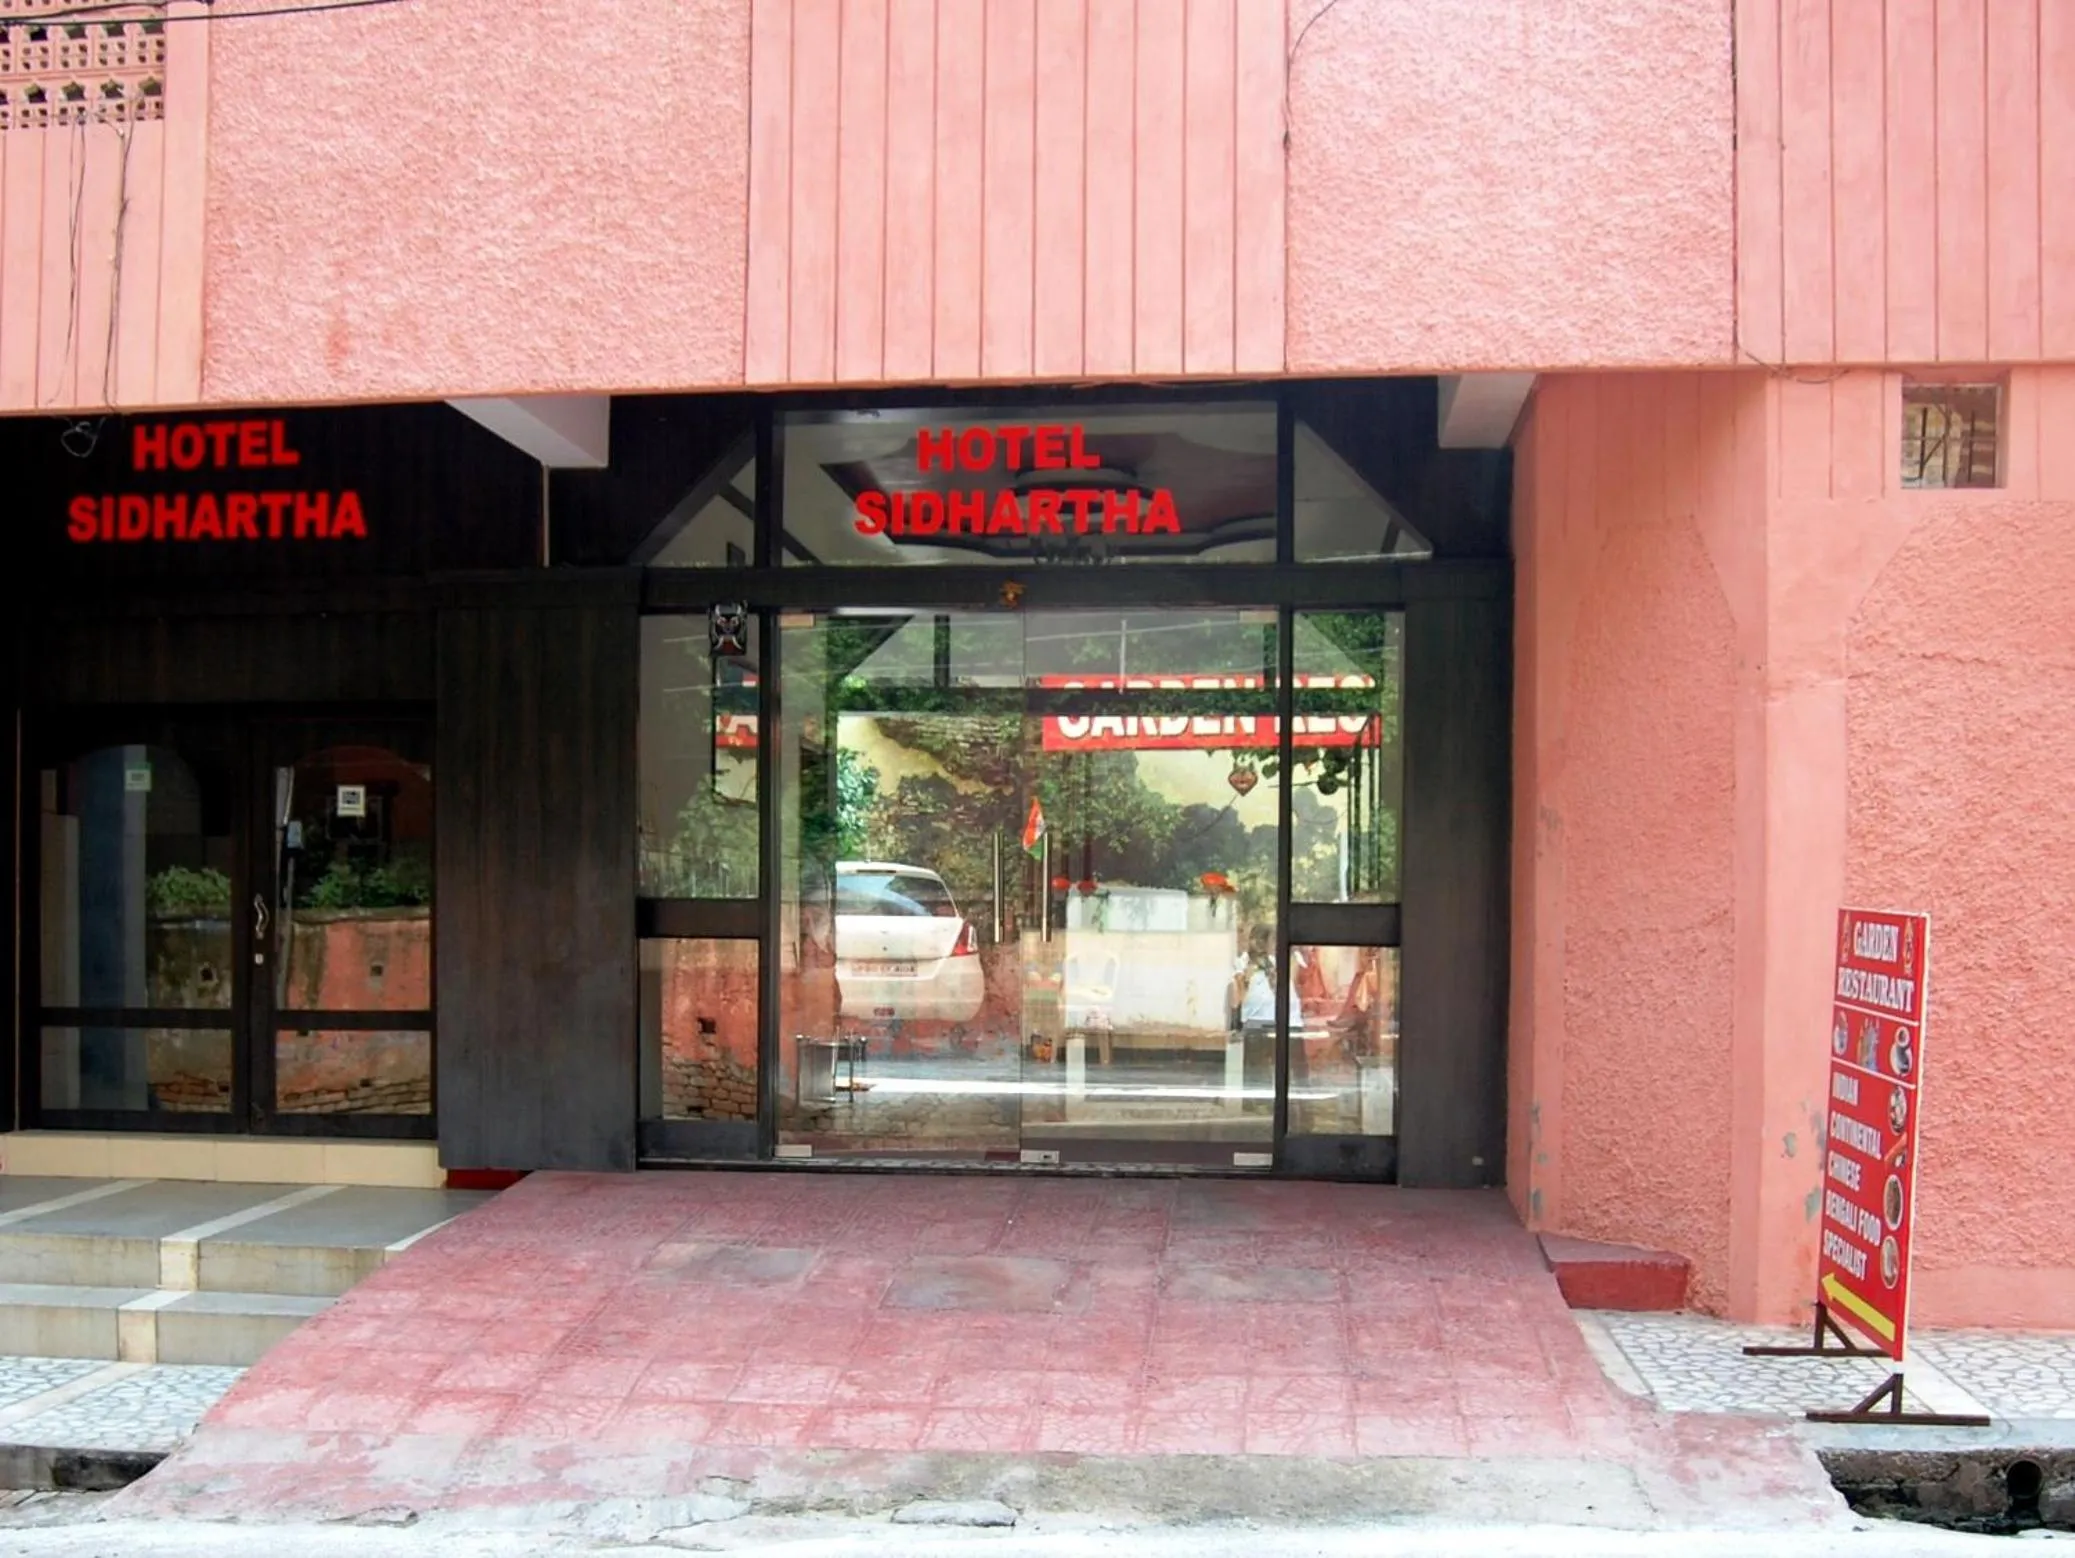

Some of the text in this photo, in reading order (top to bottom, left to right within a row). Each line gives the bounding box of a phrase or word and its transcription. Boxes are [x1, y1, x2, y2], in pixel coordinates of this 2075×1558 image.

[133, 419, 300, 470] HOTEL
[915, 424, 1103, 474] HOTEL
[67, 490, 367, 542] SIDHARTHA
[853, 487, 1182, 536] SIDHARTHA
[1853, 920, 1900, 963] GARDEN
[1836, 966, 1915, 1013] RESTAURANT
[1830, 1110, 1882, 1160] CONTINENTAL
[1827, 1150, 1861, 1192] CHINESE
[1825, 1189, 1881, 1247] BENGALI FOOD
[1823, 1228, 1867, 1281] SPECIALIST
